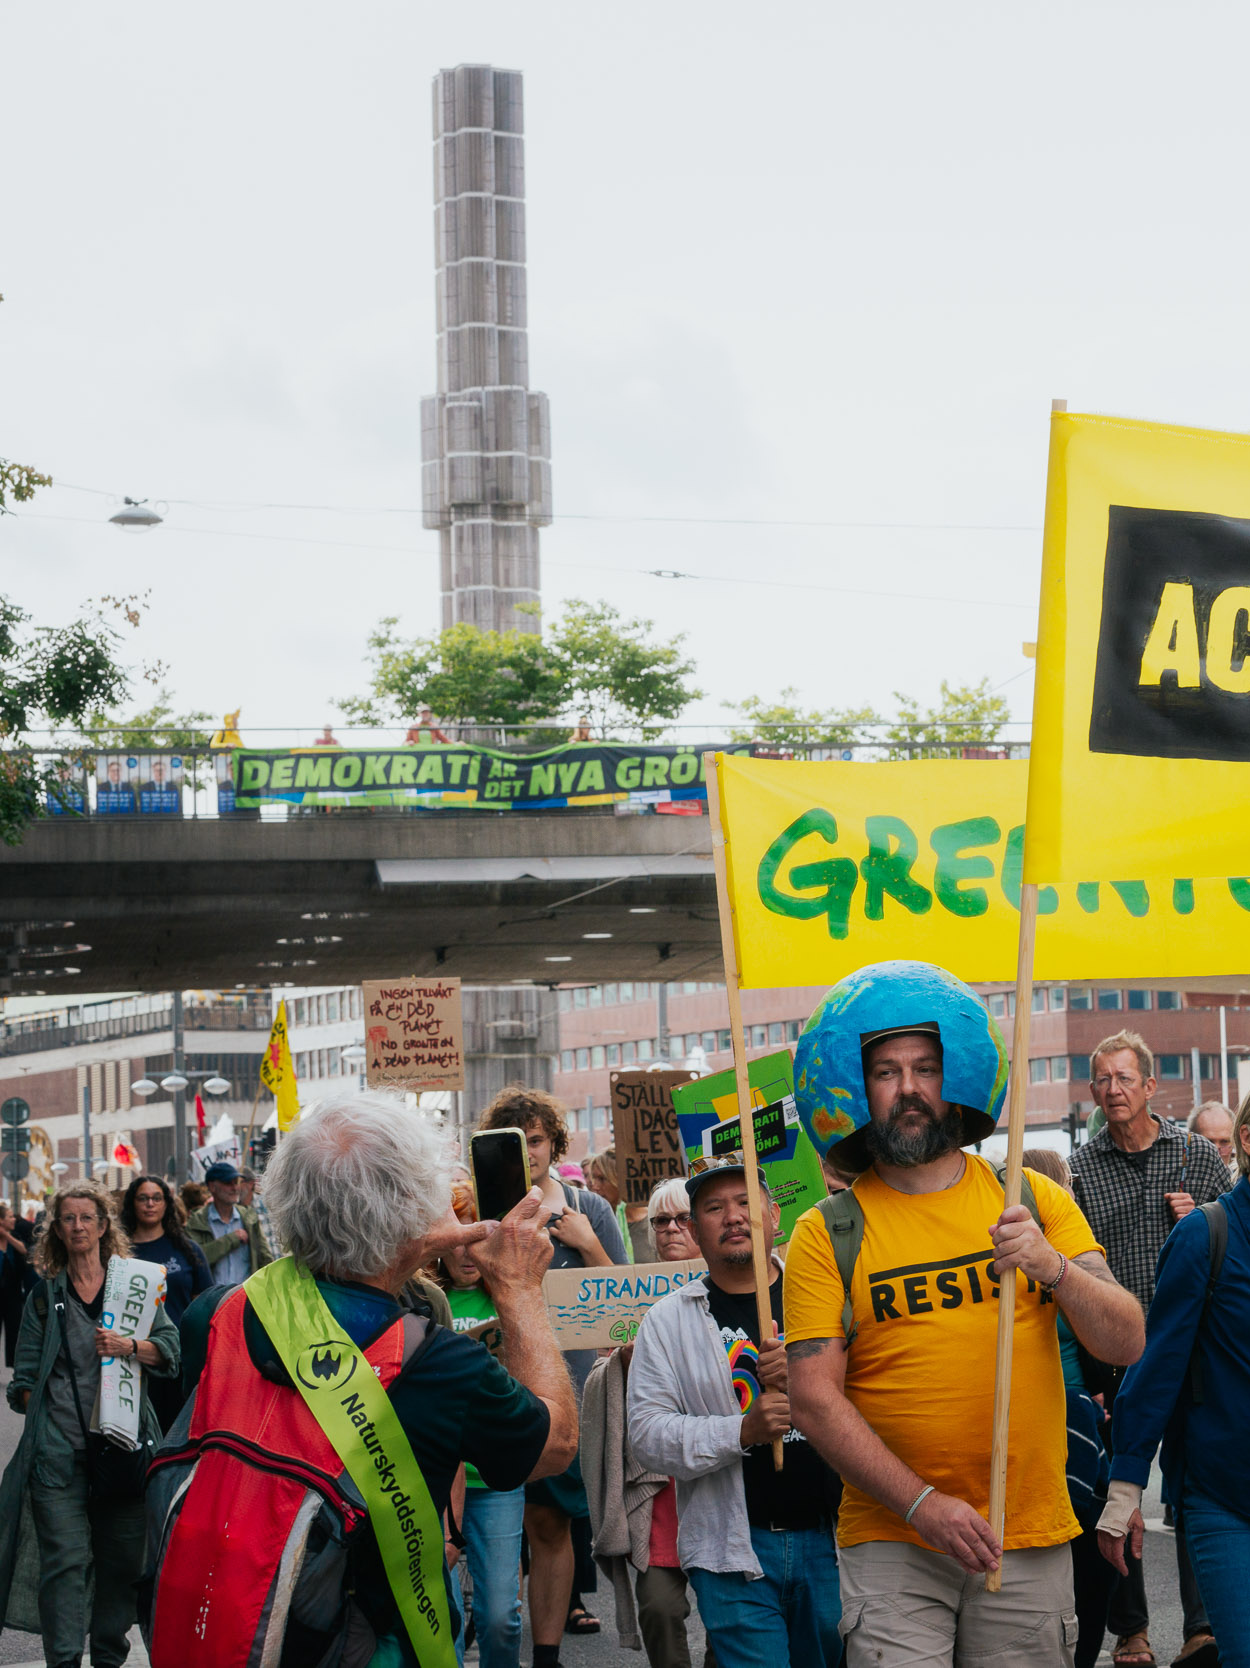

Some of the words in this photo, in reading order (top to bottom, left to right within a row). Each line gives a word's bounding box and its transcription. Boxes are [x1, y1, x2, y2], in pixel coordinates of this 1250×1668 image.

[241, 755, 482, 790] DEMOKRATI
[487, 758, 518, 778] ÄR
[528, 759, 605, 796] NYA
[615, 746, 707, 789] GRÖ
[484, 780, 525, 799] DET
[380, 988, 414, 1000] INGEN
[370, 1000, 383, 1016] PÅ
[386, 1002, 403, 1020] EN
[407, 1000, 435, 1019] DÖD
[399, 1018, 444, 1035] PLANET
[381, 1040, 397, 1050] NO
[372, 1058, 381, 1069] A
[384, 1053, 411, 1068] DEAD
[715, 1110, 779, 1144] DEMRATI
[578, 1270, 710, 1302] STRANDSK
[118, 1273, 149, 1414] GREENEACE
[340, 1392, 441, 1637] Naturskyddsföreningen
